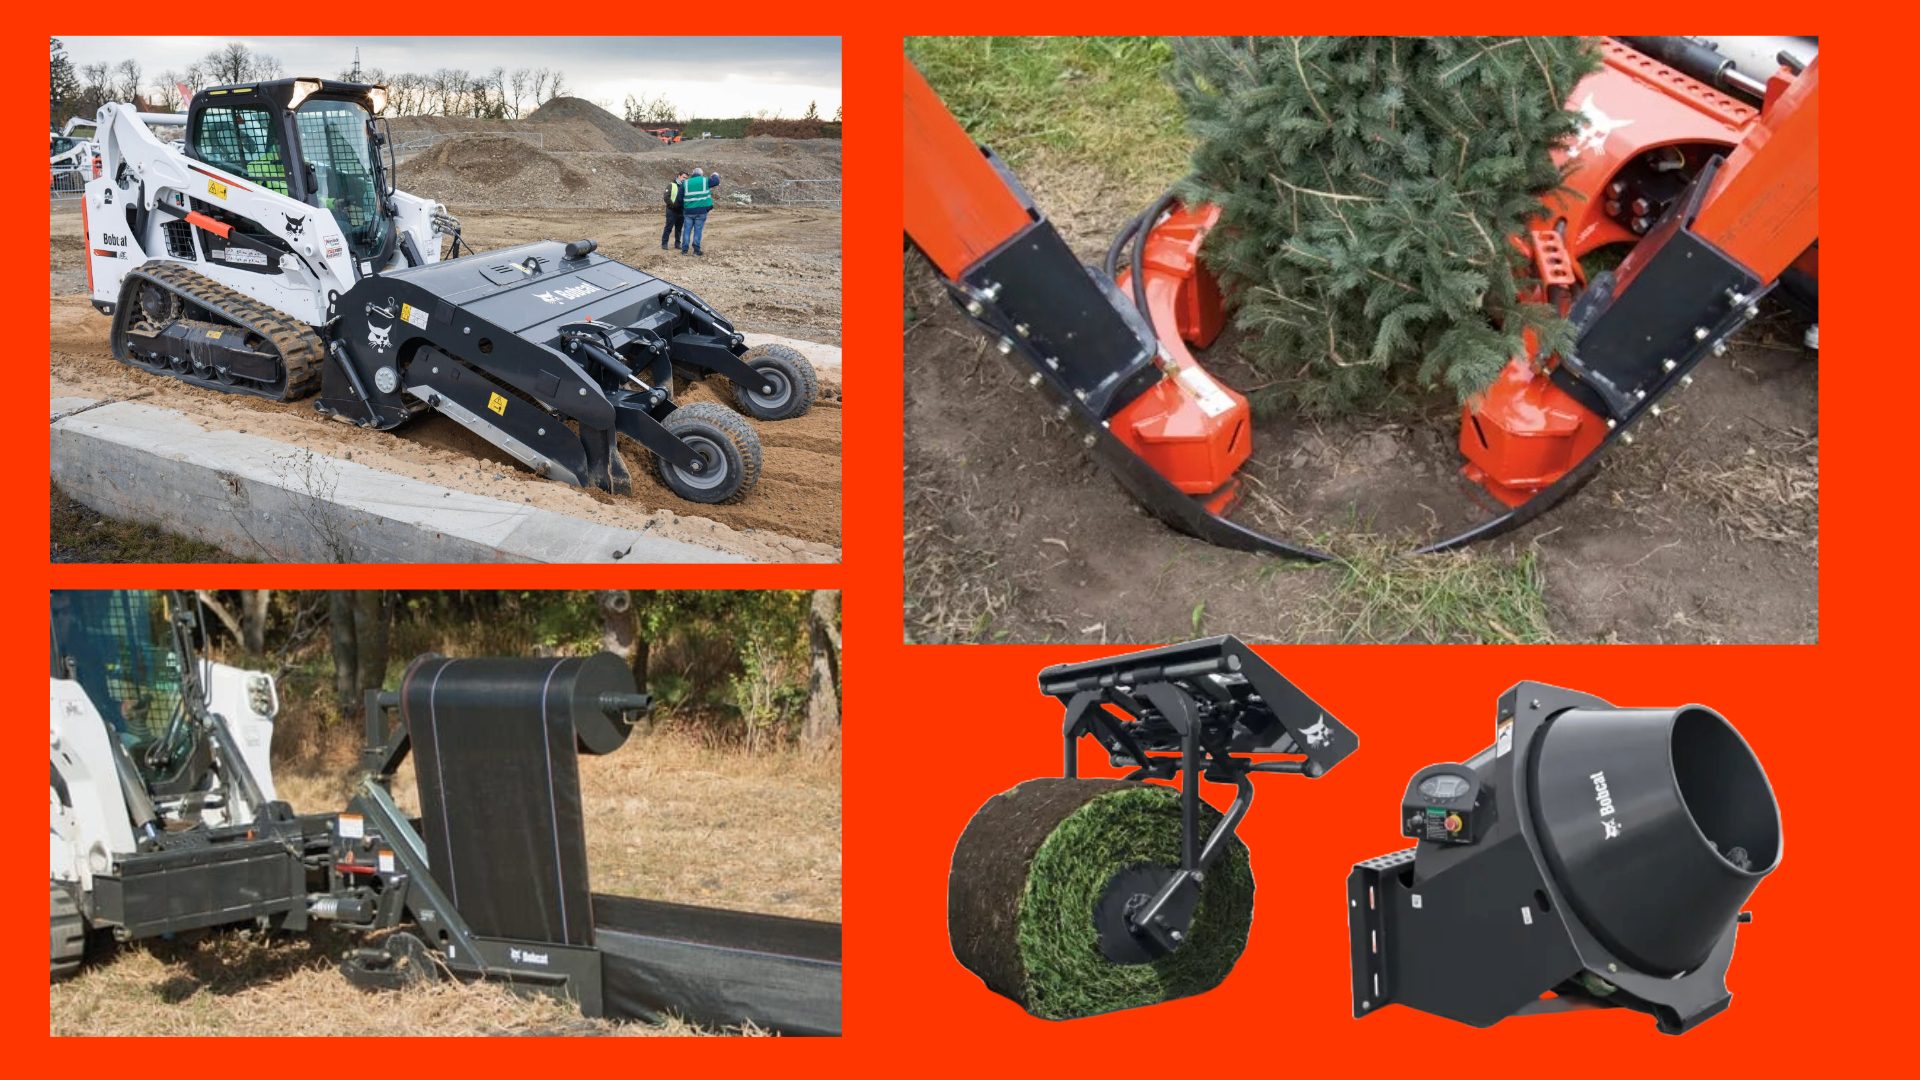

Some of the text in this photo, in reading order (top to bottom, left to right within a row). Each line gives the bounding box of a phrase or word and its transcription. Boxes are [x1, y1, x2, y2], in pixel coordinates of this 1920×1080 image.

[553, 282, 600, 300] Bobcat
[1590, 770, 1615, 817] Bobcat
[522, 951, 548, 964] Bobcat
